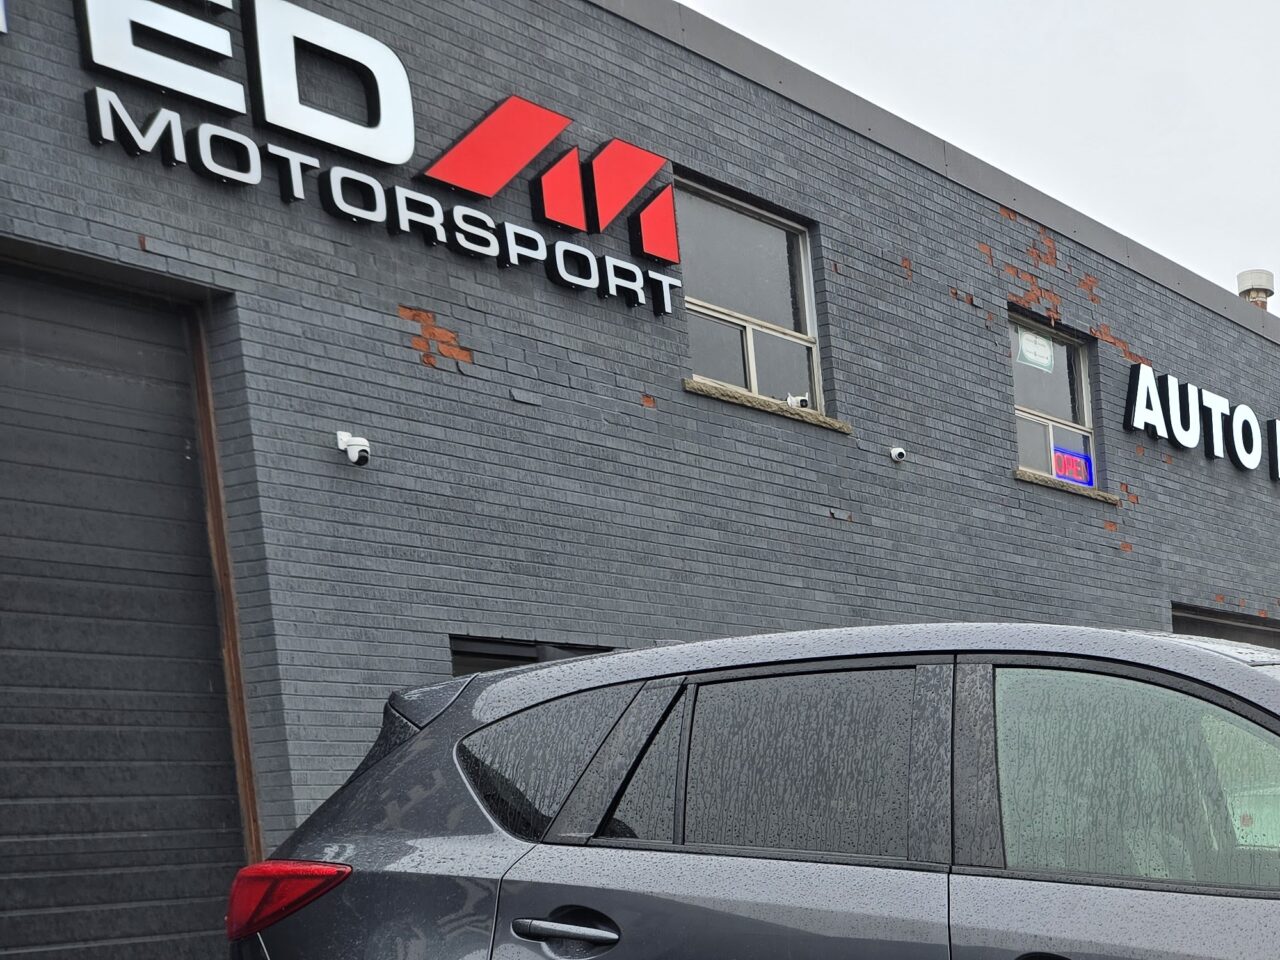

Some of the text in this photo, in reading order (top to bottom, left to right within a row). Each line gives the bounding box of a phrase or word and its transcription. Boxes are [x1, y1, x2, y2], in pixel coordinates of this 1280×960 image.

[0, 0, 416, 165] ED
[95, 86, 682, 315] MOTORSPORT
[1055, 452, 1088, 482] OPEN
[1131, 363, 1262, 471] AUTO
